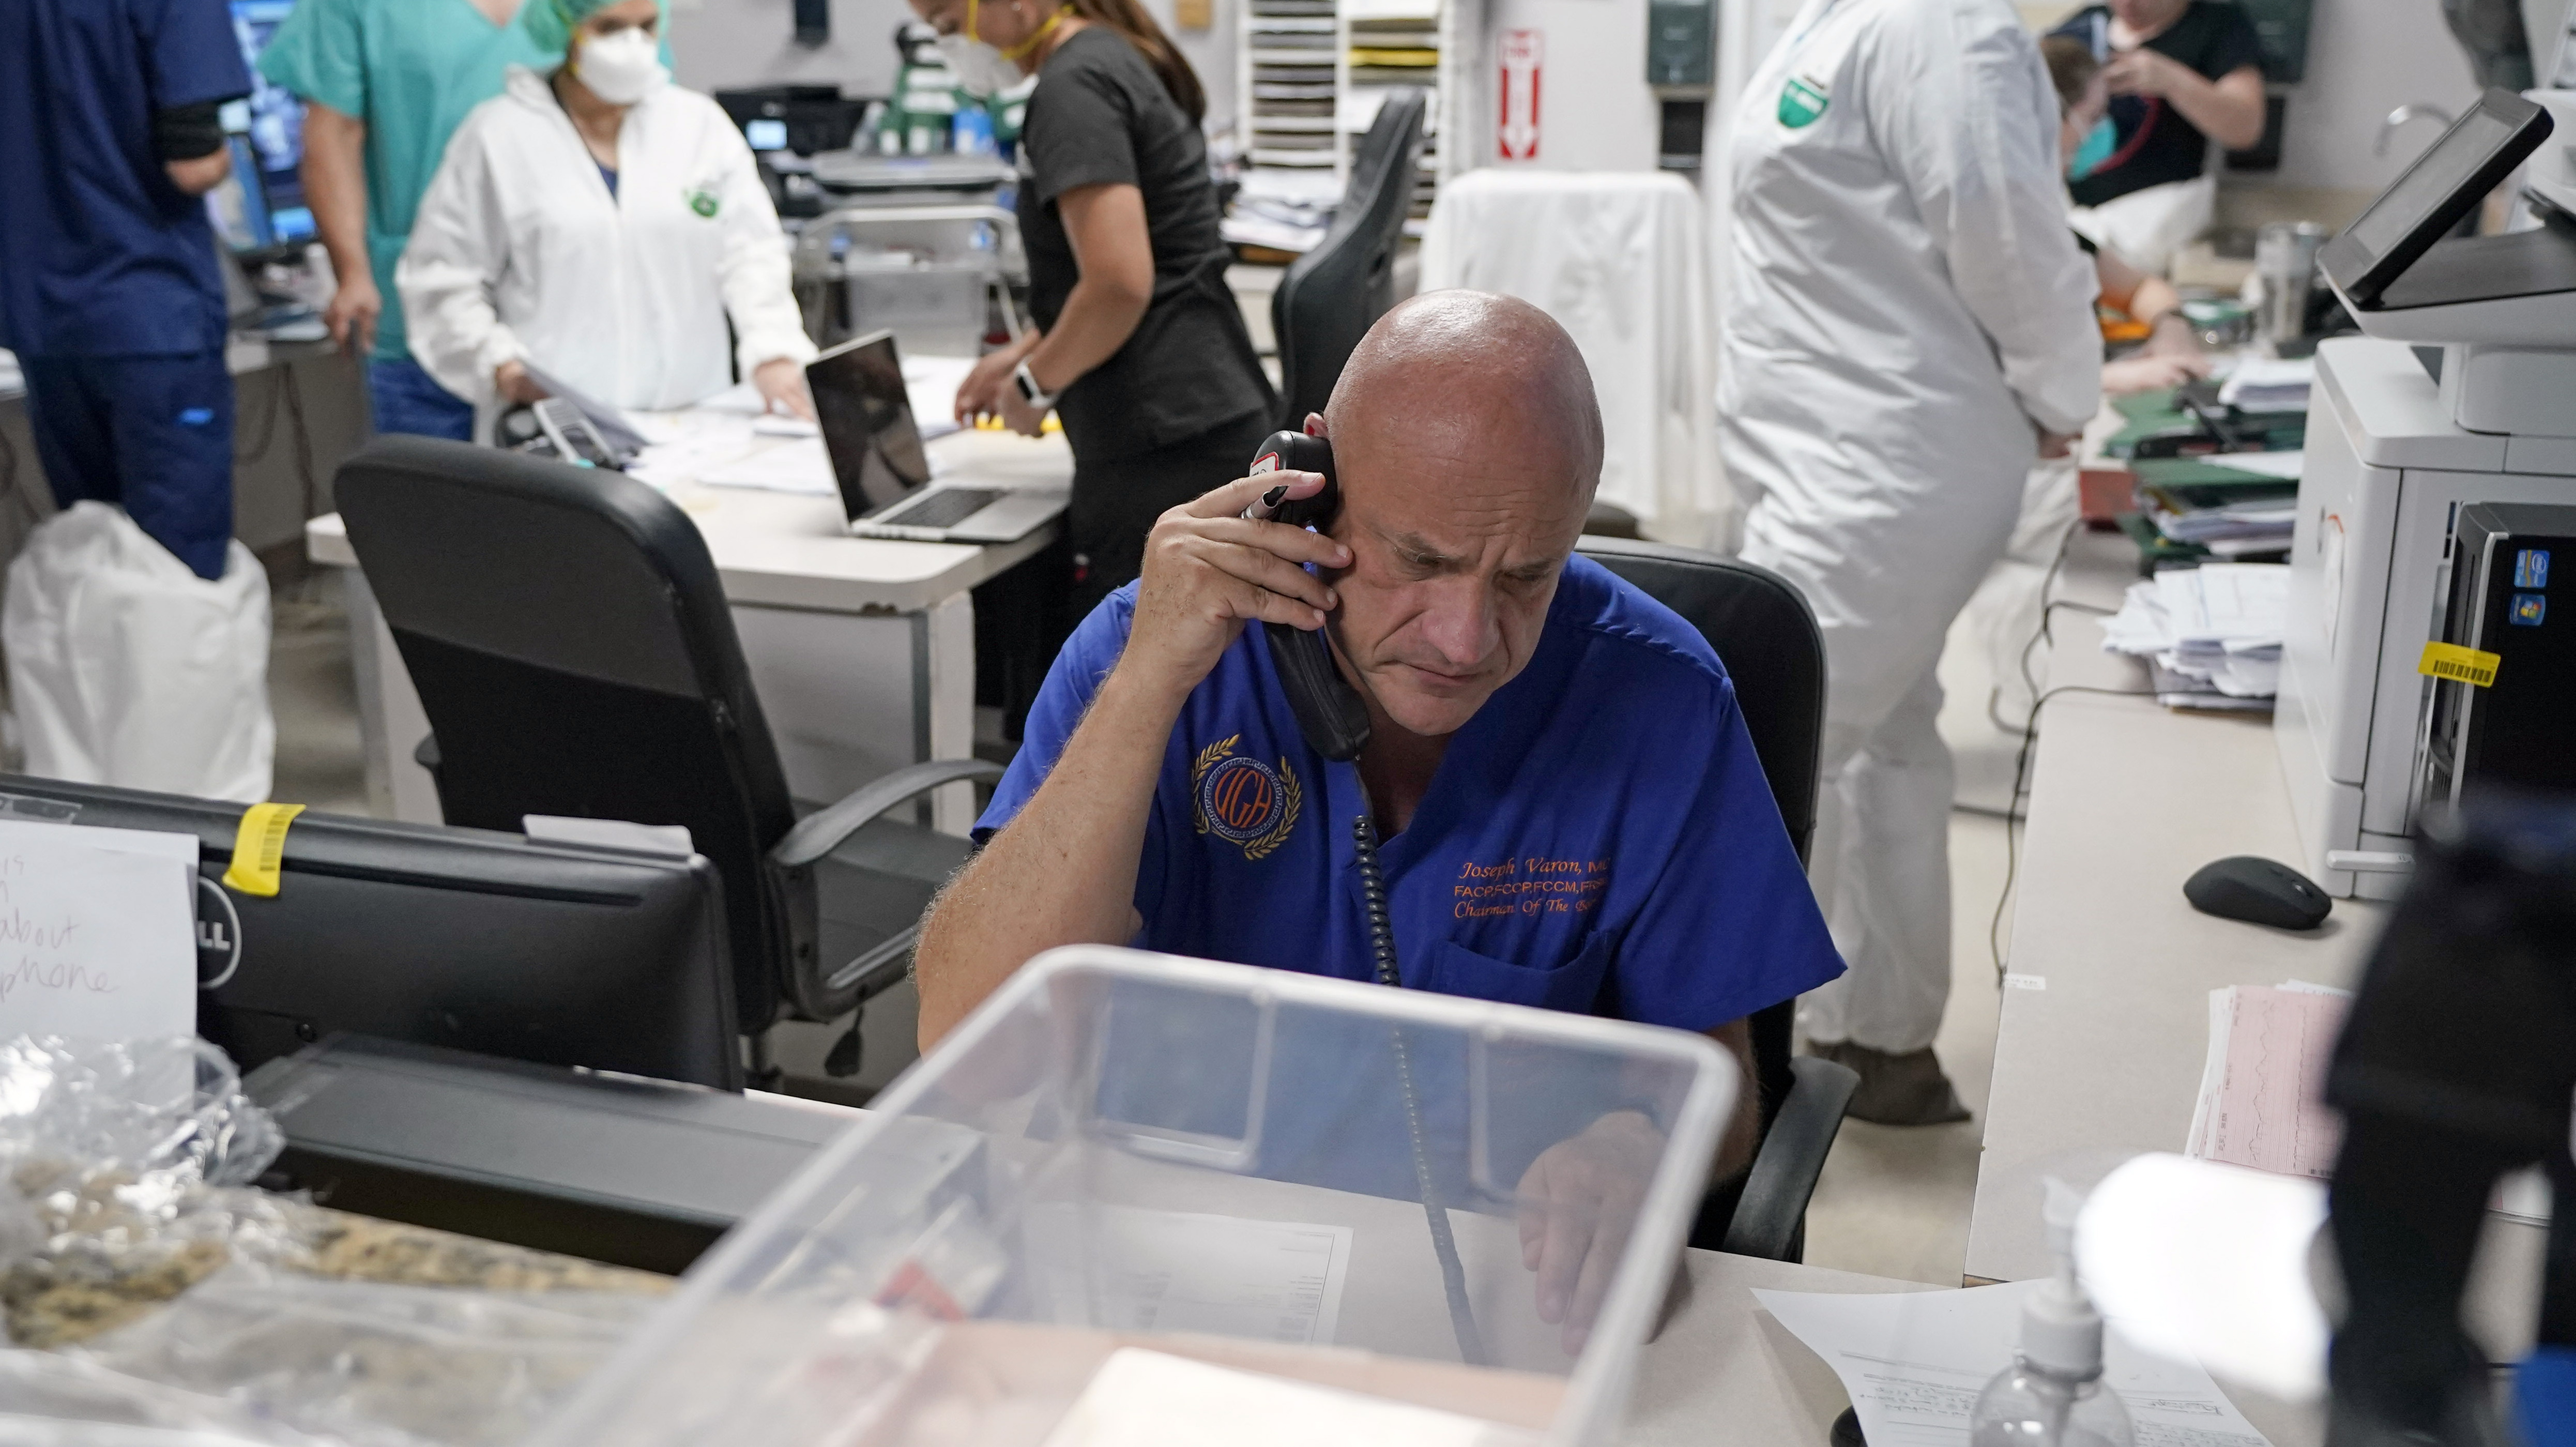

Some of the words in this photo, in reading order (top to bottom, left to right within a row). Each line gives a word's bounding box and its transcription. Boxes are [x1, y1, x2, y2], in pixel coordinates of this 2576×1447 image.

[1459, 857, 1515, 880] Joseph
[1525, 857, 1582, 875] Varon,
[1455, 900, 1515, 918] Chairman
[1522, 898, 1543, 916] Of
[1546, 898, 1568, 912] The
[197, 920, 231, 950] LL
